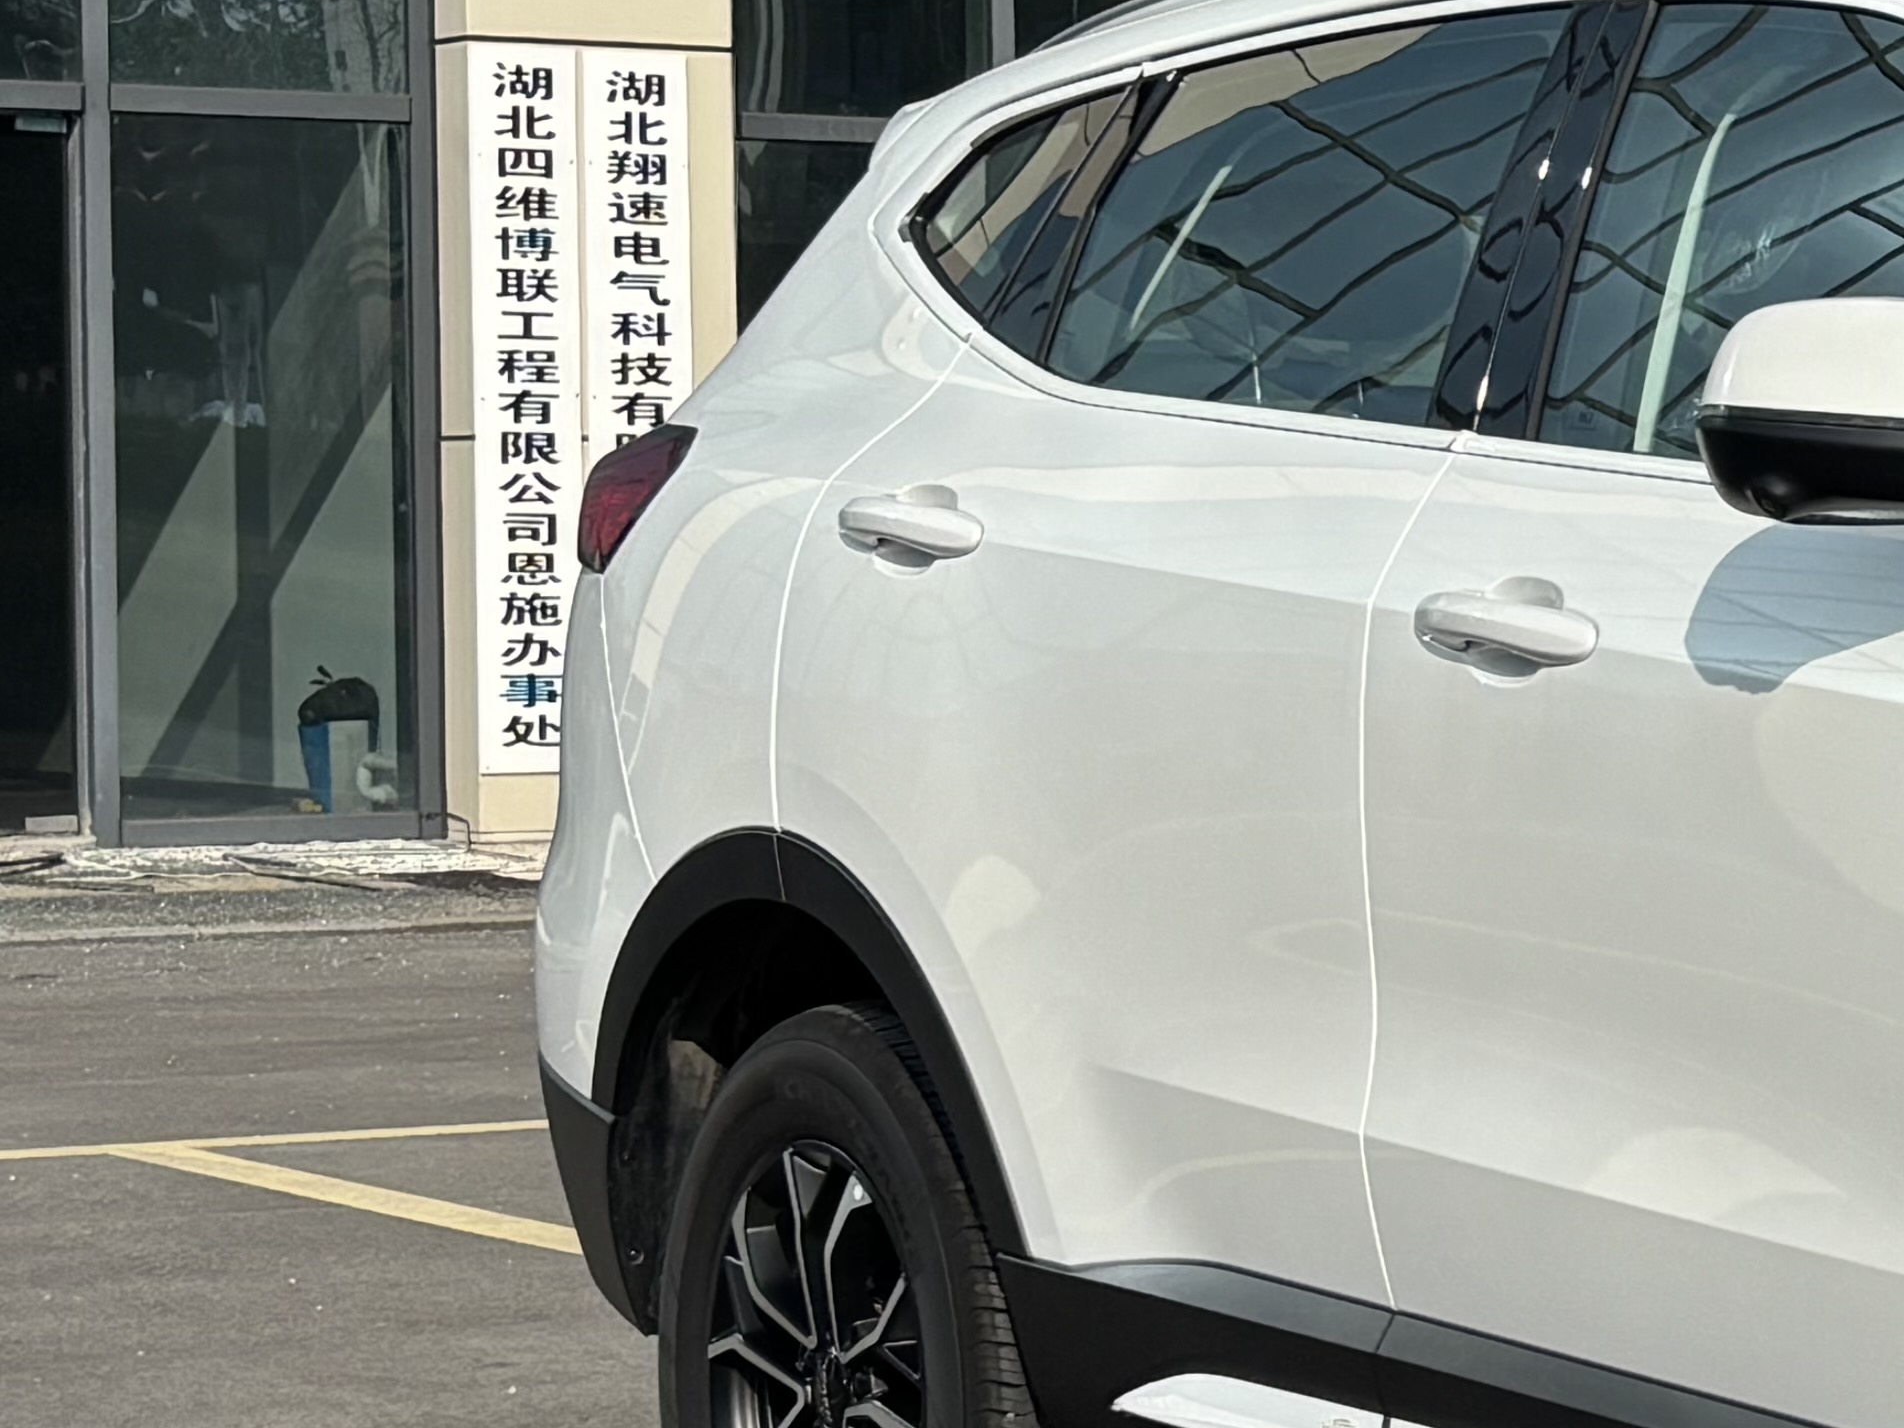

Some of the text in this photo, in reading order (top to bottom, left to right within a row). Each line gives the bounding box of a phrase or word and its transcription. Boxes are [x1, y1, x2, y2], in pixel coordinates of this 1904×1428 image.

[493, 62, 562, 747] 湖北四维博联工程有限公司恩施办事处
[606, 71, 673, 449] 湖北翔速电气科技有
